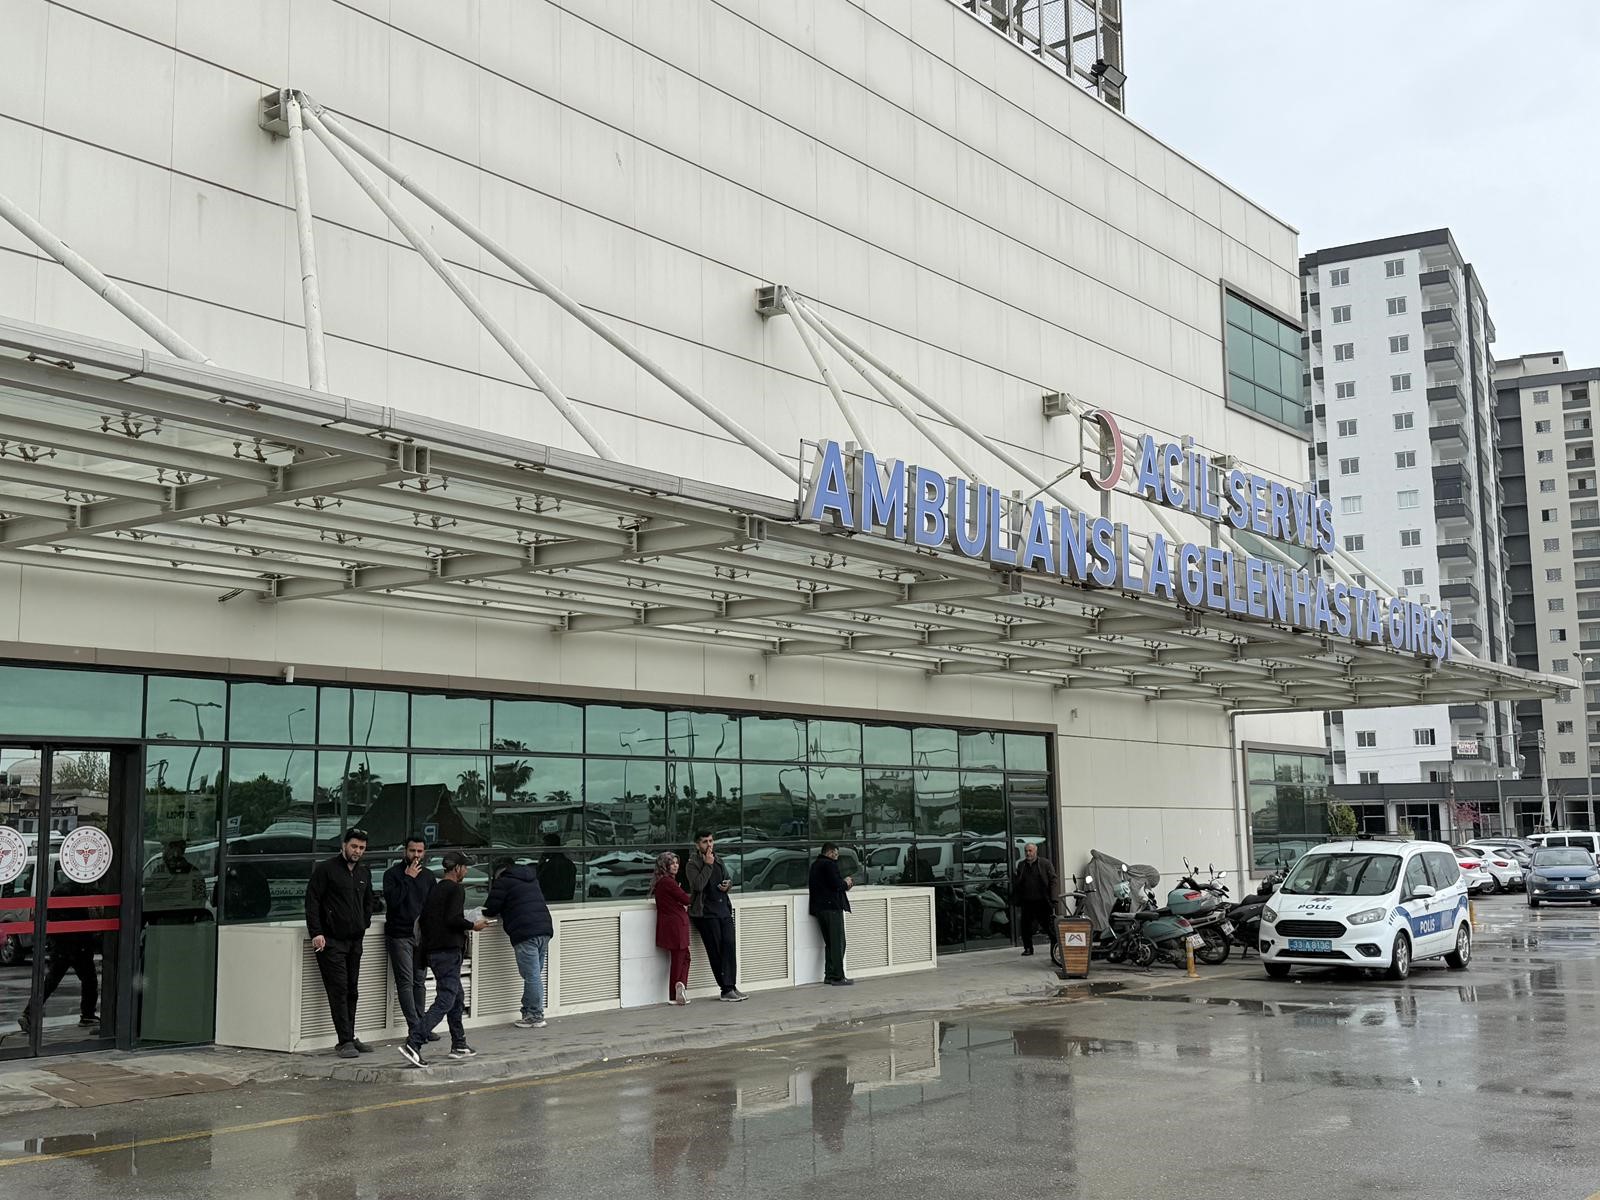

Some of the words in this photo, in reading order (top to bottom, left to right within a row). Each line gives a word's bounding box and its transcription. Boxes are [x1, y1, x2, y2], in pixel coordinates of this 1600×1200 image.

[1137, 432, 1220, 520] ACİL
[1225, 469, 1336, 554] SERVİS
[804, 439, 1173, 599] AMBULANSLA
[1178, 543, 1287, 622] GELEN
[1291, 569, 1382, 642] HASTA
[1297, 903, 1334, 911] POLİS
[1419, 916, 1436, 933] POLİS
